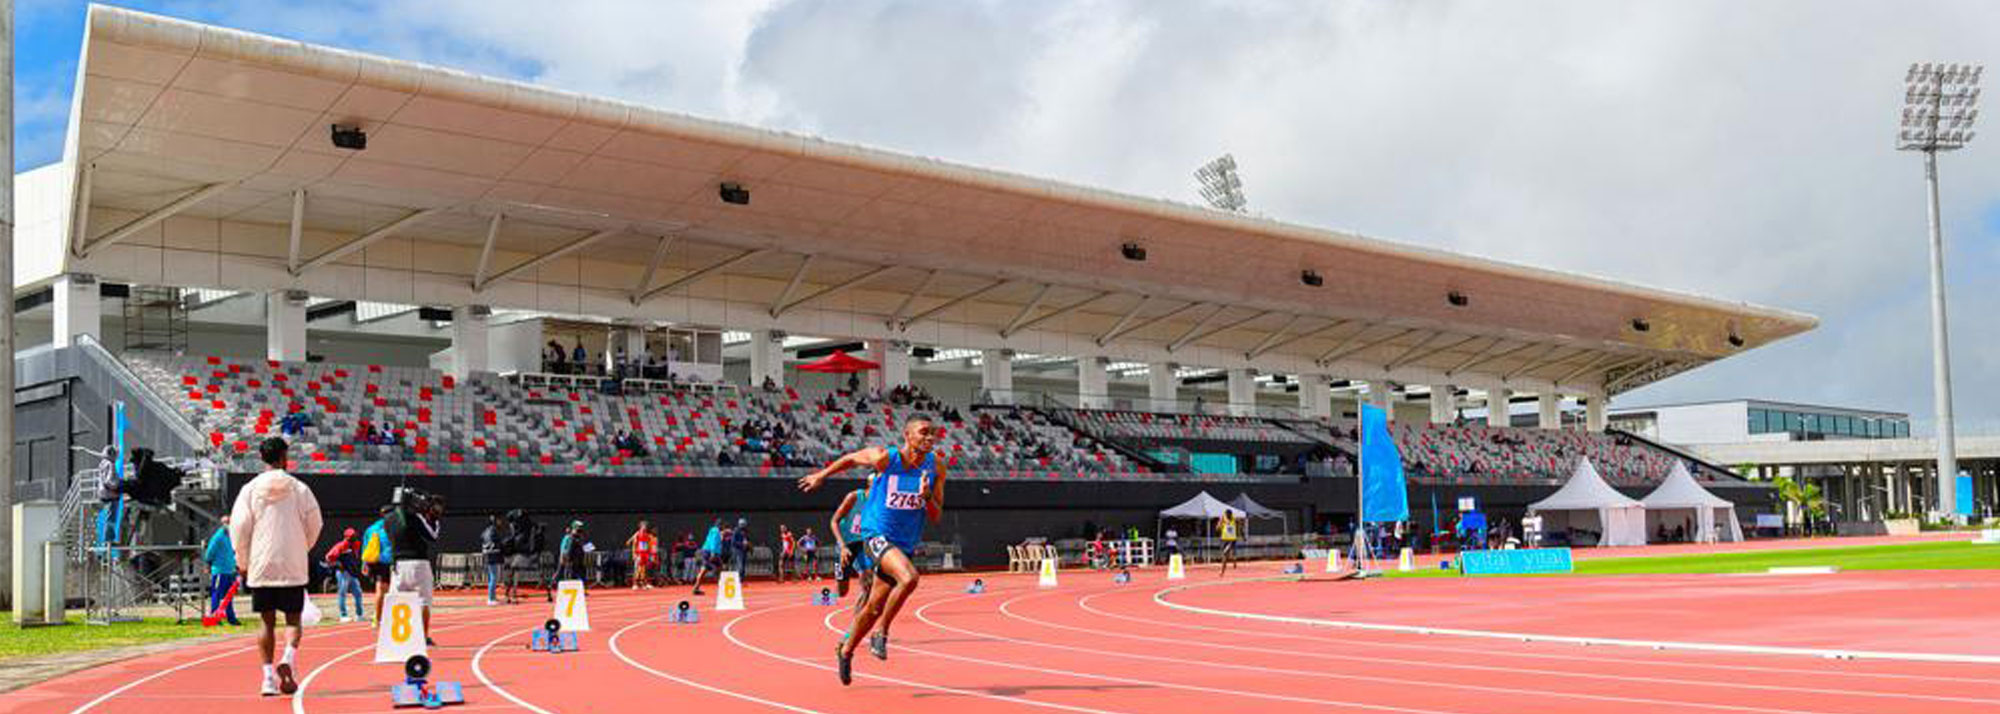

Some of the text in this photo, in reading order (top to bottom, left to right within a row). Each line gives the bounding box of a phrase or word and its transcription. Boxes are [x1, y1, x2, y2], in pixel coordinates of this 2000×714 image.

[724, 577, 736, 598] 6
[562, 589, 577, 617] 7
[391, 604, 412, 642] 8
